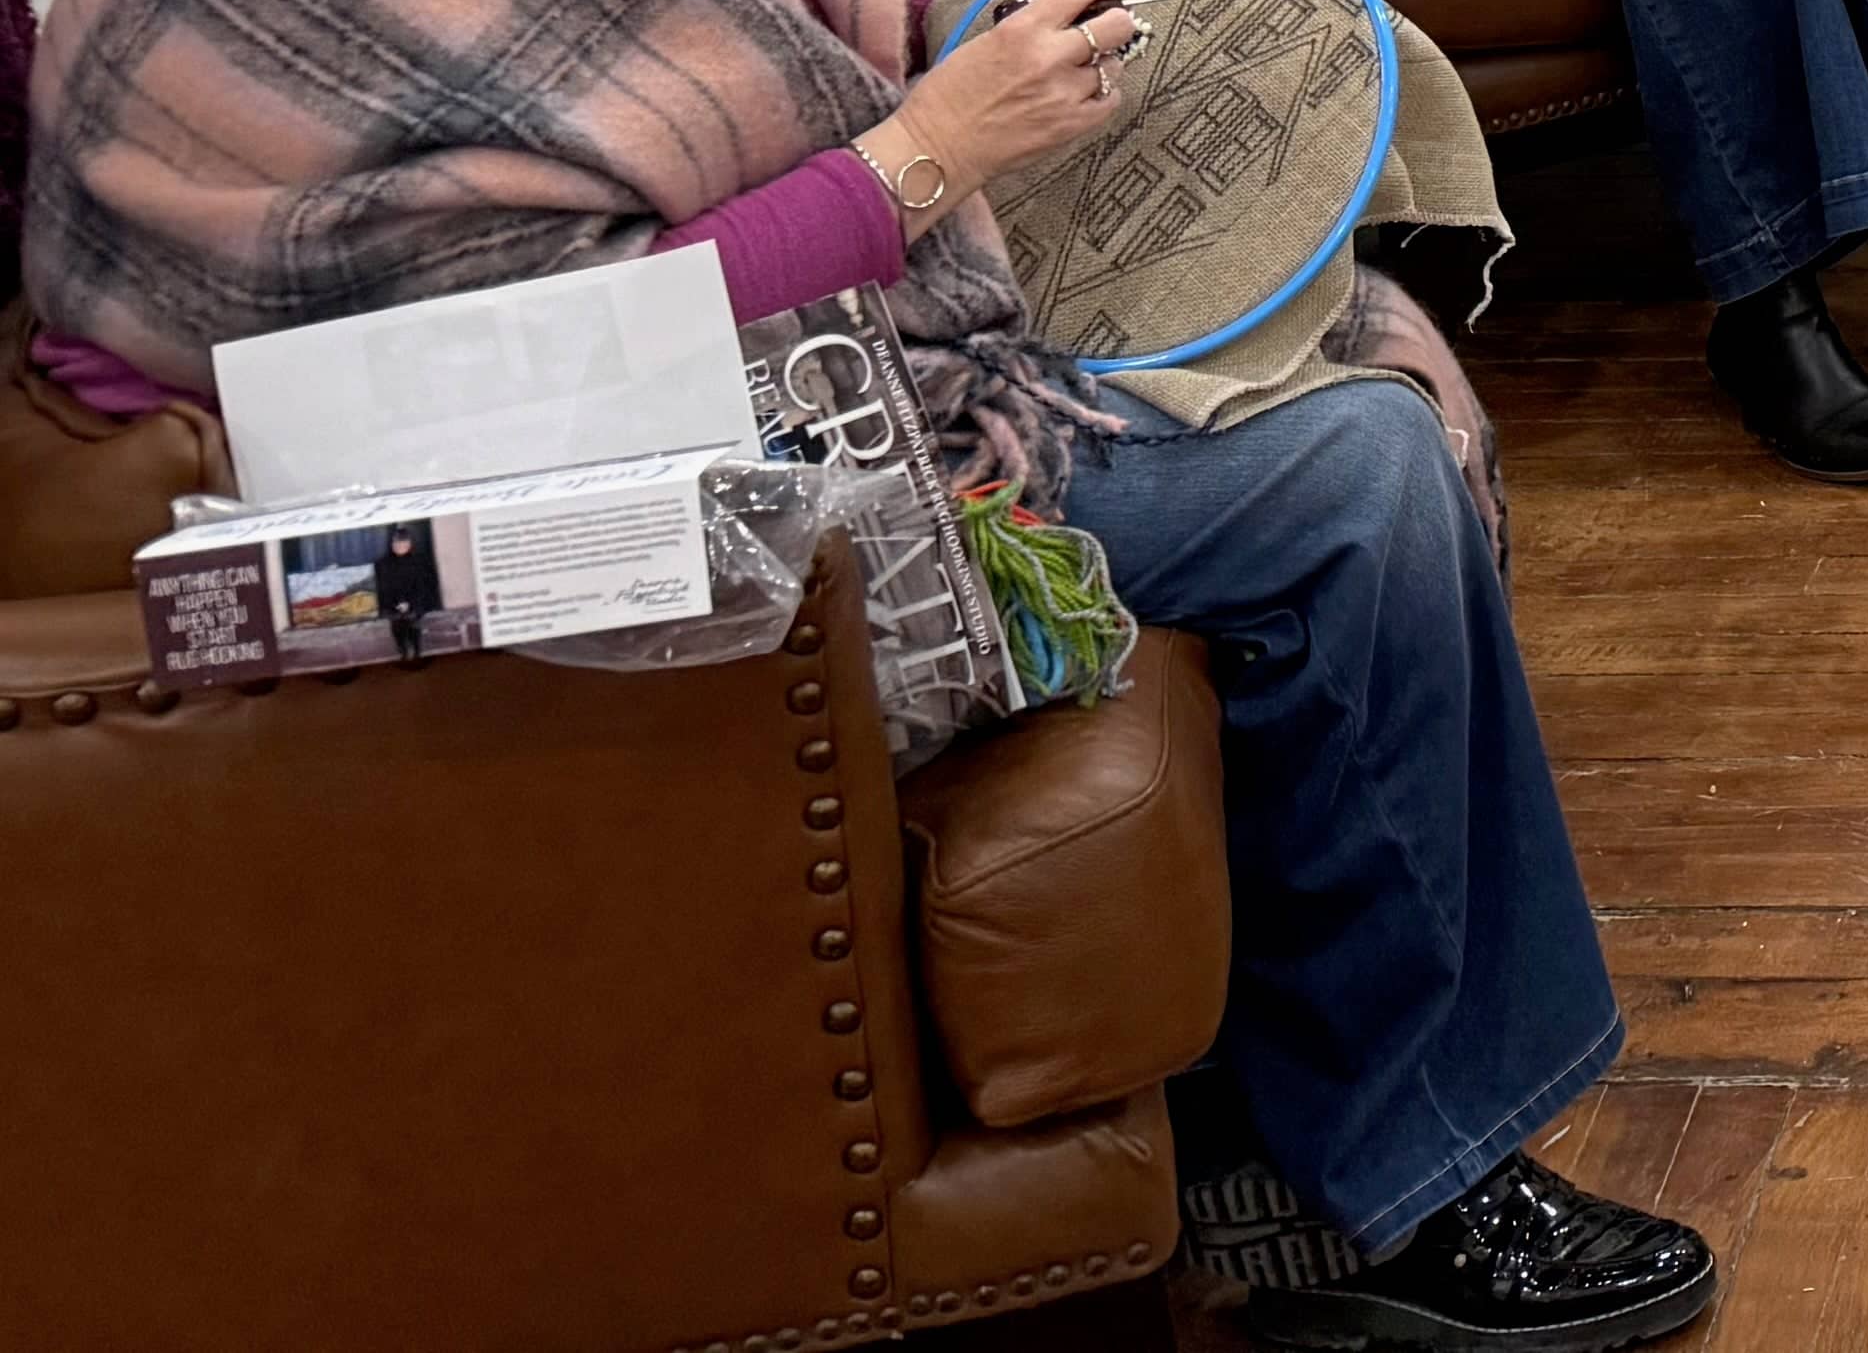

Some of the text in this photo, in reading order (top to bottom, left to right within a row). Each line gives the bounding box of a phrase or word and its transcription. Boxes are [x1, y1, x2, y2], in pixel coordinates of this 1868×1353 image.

[744, 358, 806, 465] BEAU
[872, 339, 993, 656] DEANNE FITZPATRICK RUG HOOKING STUDIO
